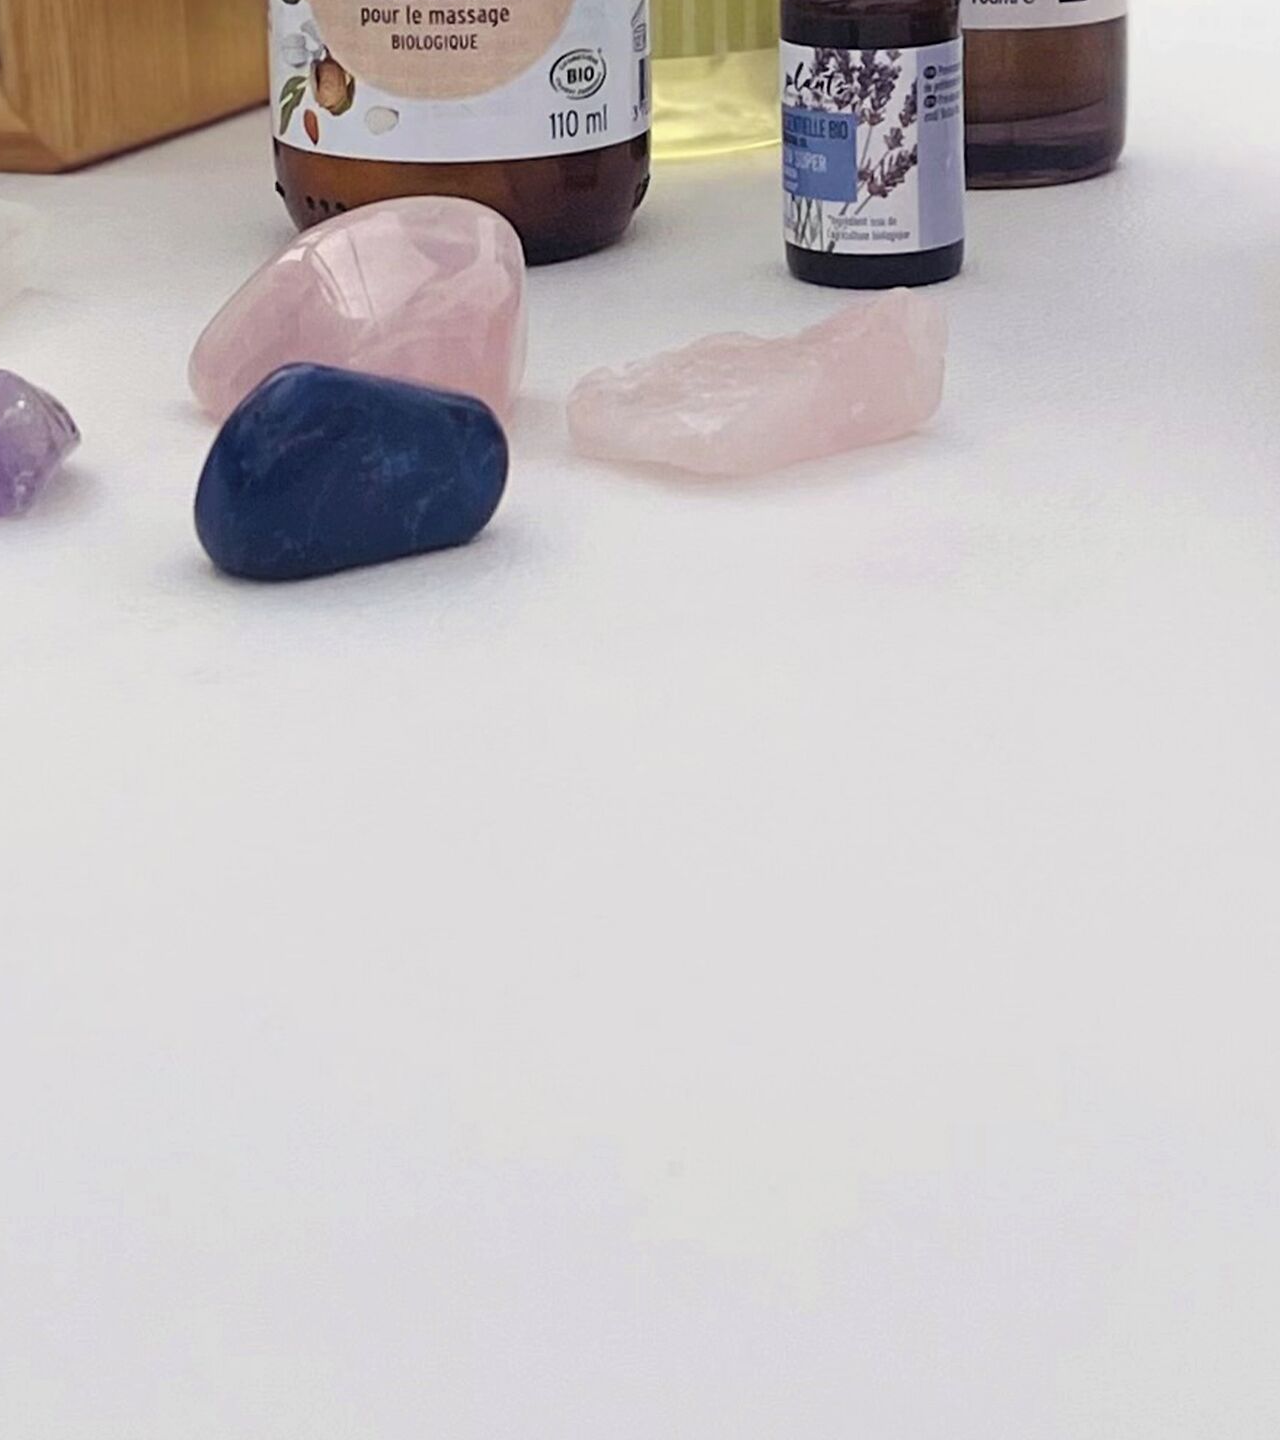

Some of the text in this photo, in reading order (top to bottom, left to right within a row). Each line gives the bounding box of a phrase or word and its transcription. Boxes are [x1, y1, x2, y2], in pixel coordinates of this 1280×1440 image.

[360, 6, 511, 28] pour le massage
[391, 33, 479, 51] BIOLOGIQUE
[566, 65, 595, 85] BIO
[548, 110, 580, 140] 110
[586, 104, 609, 135] ml
